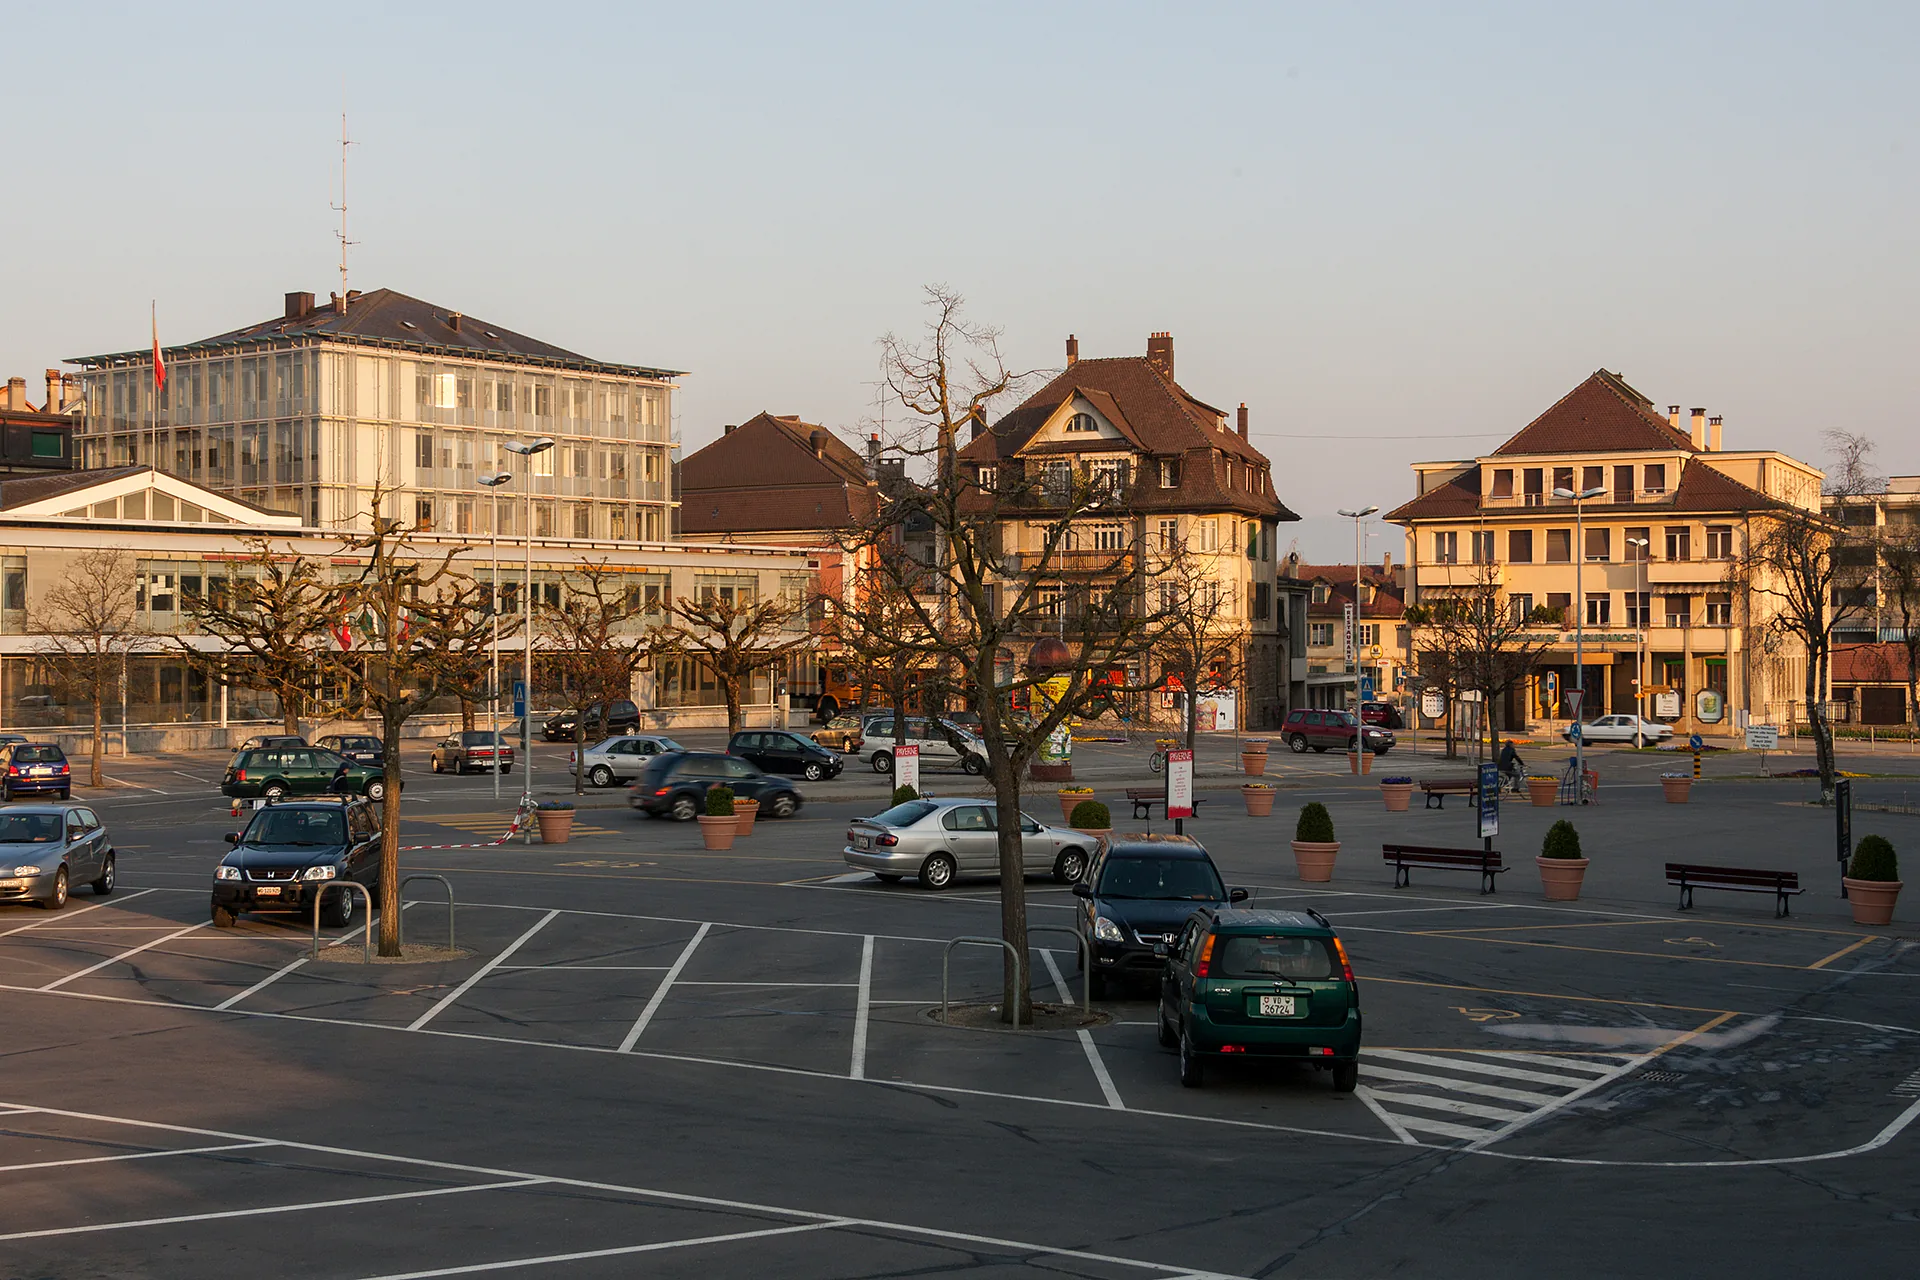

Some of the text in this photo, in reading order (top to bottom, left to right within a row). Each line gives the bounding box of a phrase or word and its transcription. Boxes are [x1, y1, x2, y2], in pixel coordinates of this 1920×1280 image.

[896, 747, 918, 756] PAYERNE
[1169, 751, 1192, 761] PAYERNE
[1272, 997, 1282, 1005] VD
[1264, 1004, 1290, 1015] 26724
